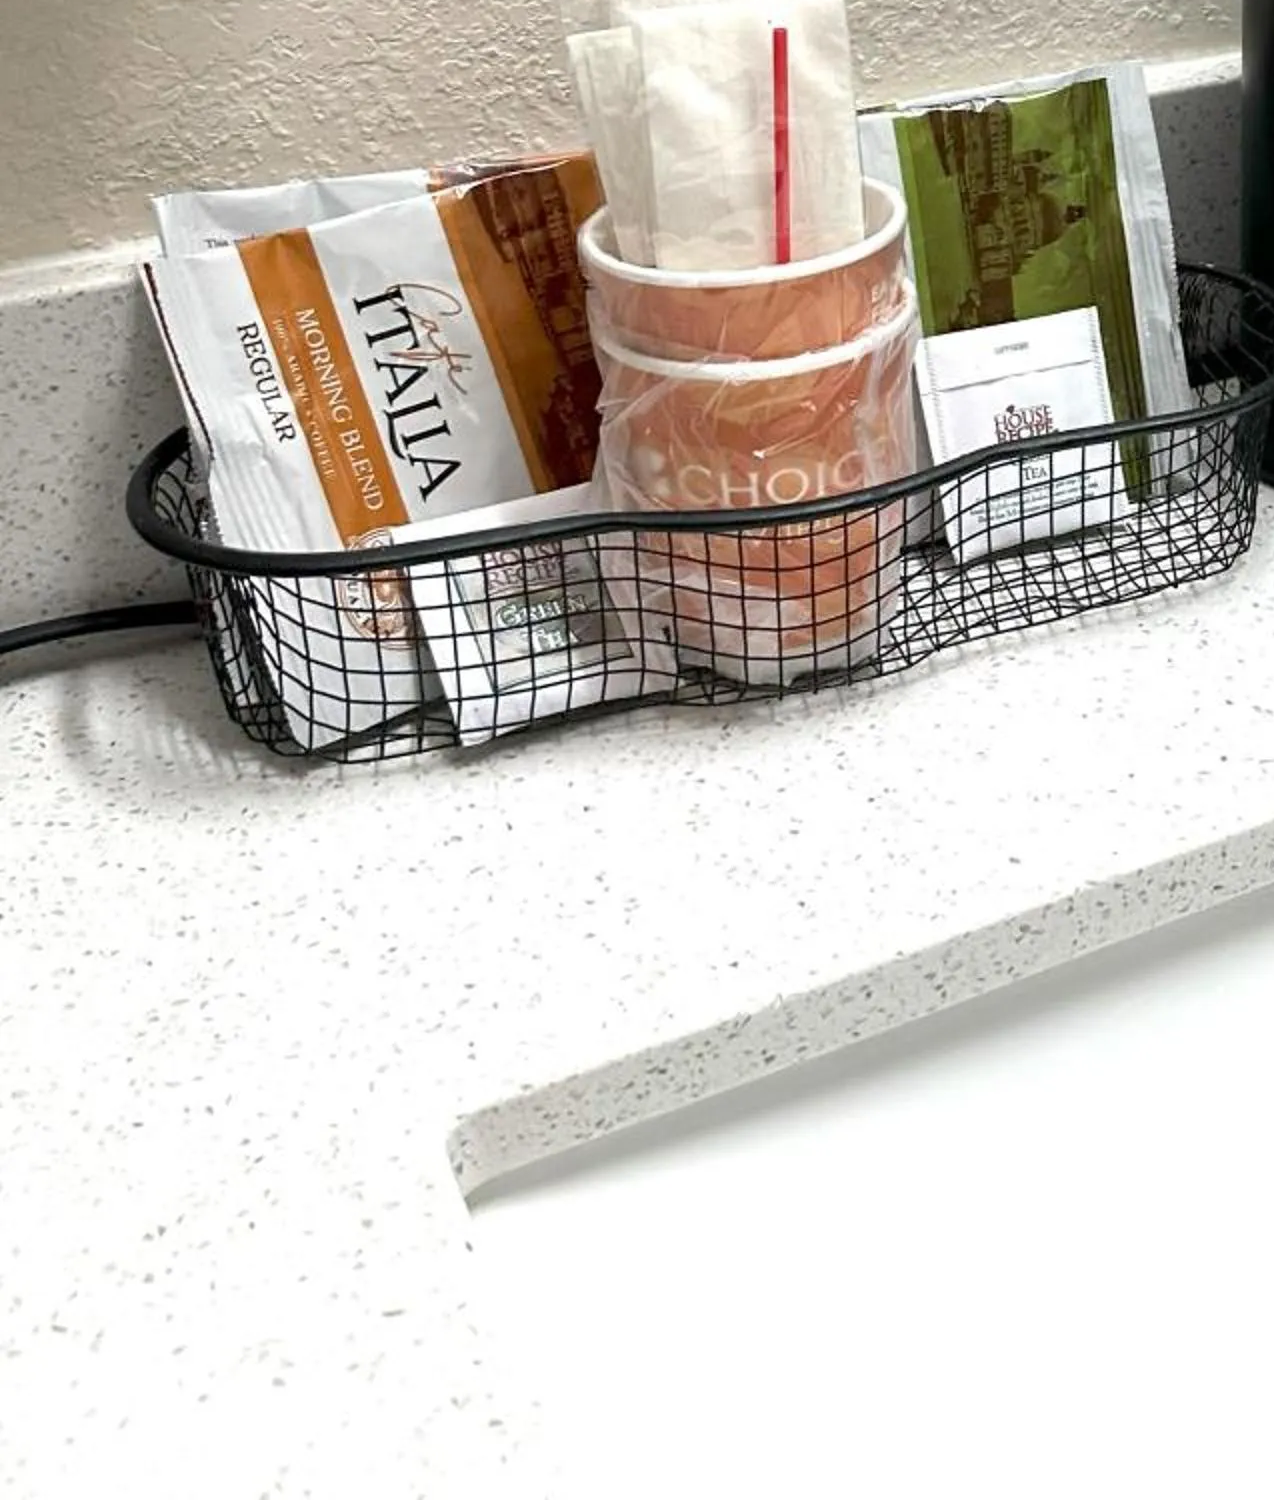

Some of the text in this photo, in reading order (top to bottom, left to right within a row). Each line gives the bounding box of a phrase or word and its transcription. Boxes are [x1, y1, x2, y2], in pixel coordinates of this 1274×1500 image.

[236, 320, 297, 444] REGULAR
[295, 307, 353, 424] MORNING
[339, 428, 385, 512] BLEND
[352, 283, 462, 503] ITALIA
[994, 405, 1052, 430] HOUSE
[677, 448, 873, 507] CHOIC
[1023, 465, 1047, 481] TEA
